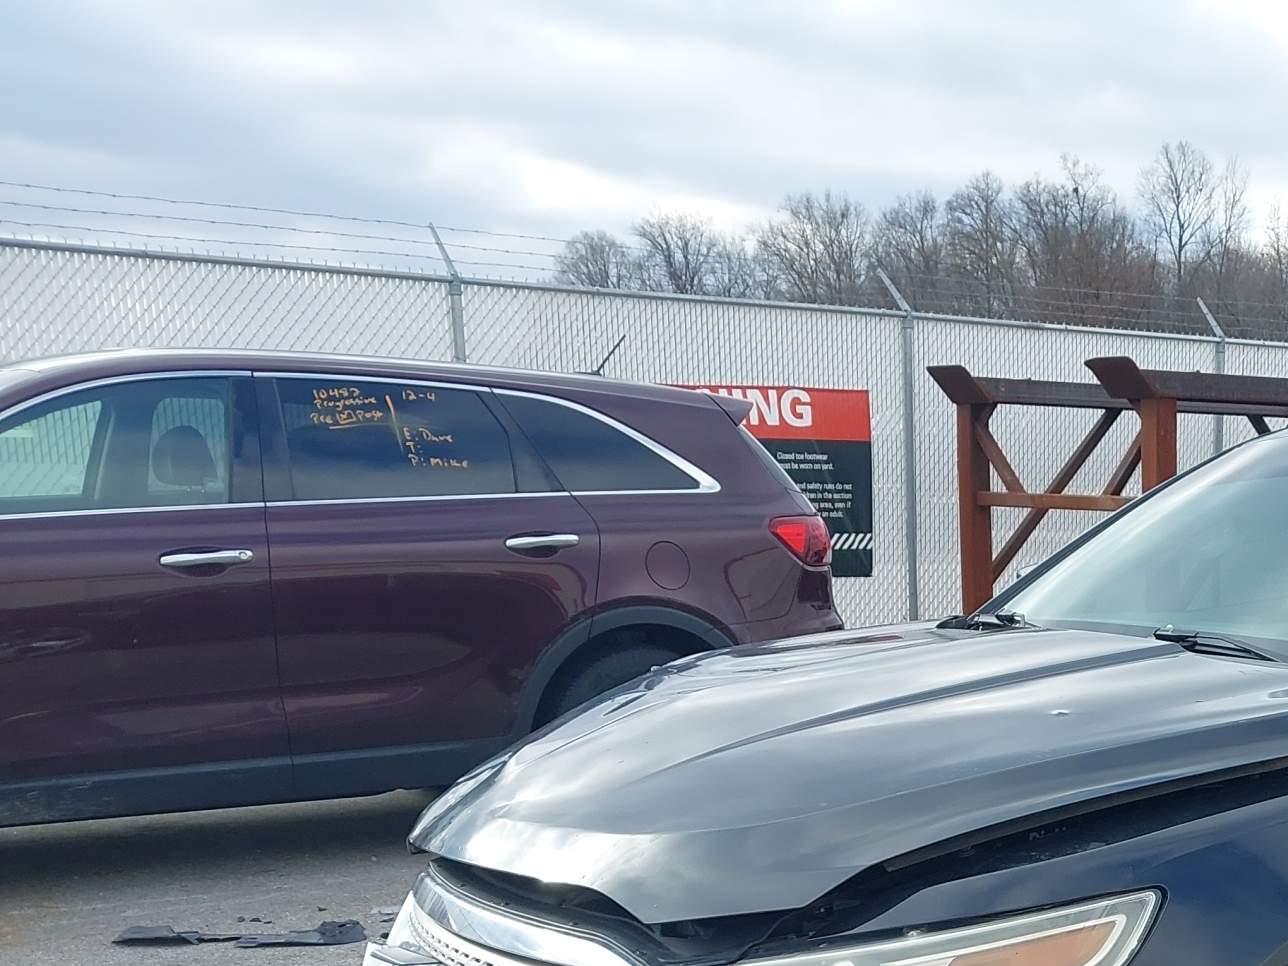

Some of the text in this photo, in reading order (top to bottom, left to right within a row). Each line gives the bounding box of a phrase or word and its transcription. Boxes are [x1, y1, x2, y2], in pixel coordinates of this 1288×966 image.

[402, 390, 435, 402] 12-4
[405, 442, 424, 455] T:
[408, 453, 427, 467] P:
[776, 451, 795, 460] Closed
[791, 462, 799, 470] be
[806, 482, 823, 491] safety
[835, 482, 843, 490] do
